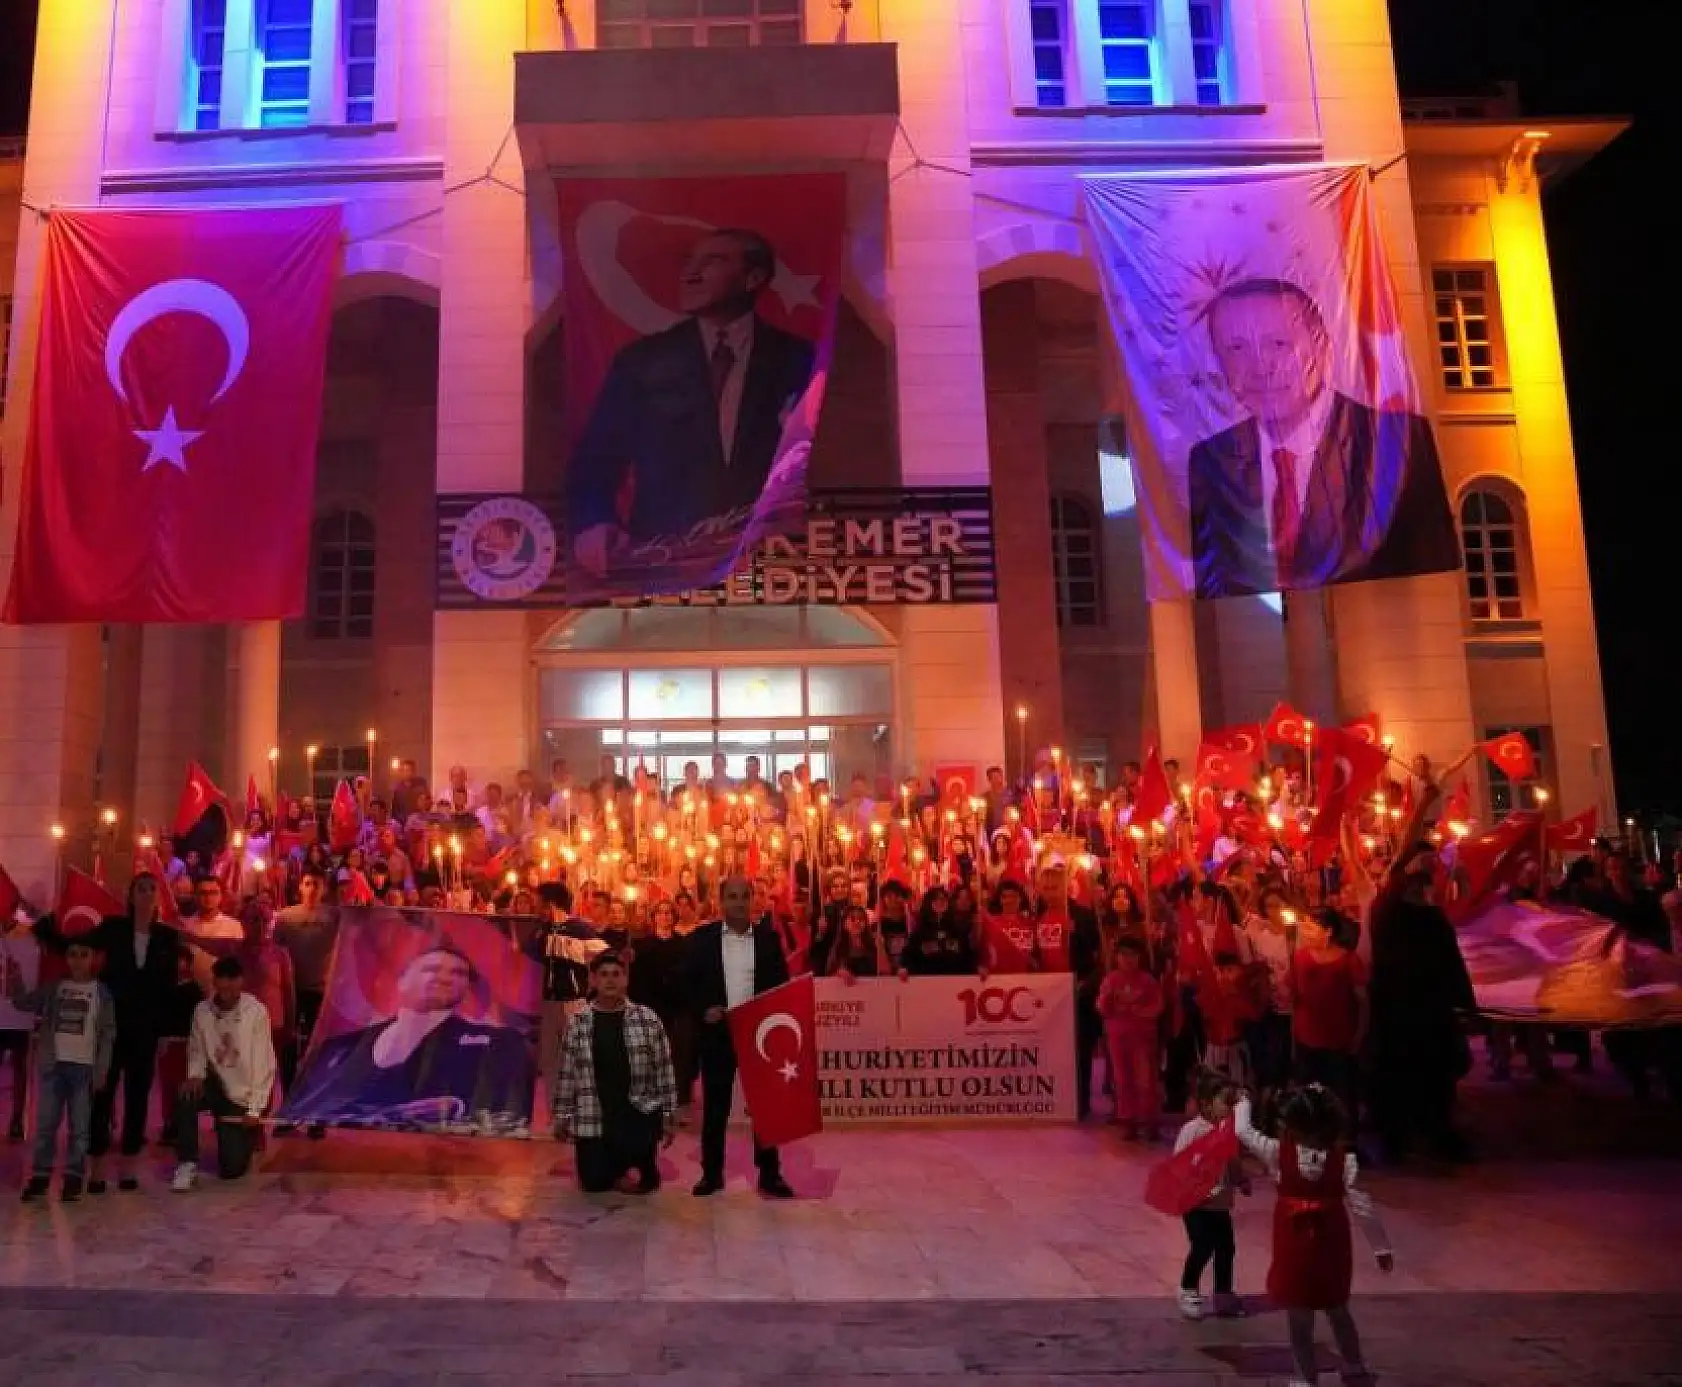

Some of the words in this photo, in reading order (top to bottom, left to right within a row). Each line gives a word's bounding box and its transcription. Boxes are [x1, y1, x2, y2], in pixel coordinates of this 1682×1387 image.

[822, 1043, 1040, 1070] HURİYETİMİZİN
[818, 1077, 855, 1100] ILI
[859, 1076, 956, 1100] KUTLU
[961, 1075, 1055, 1098] OLSUN
